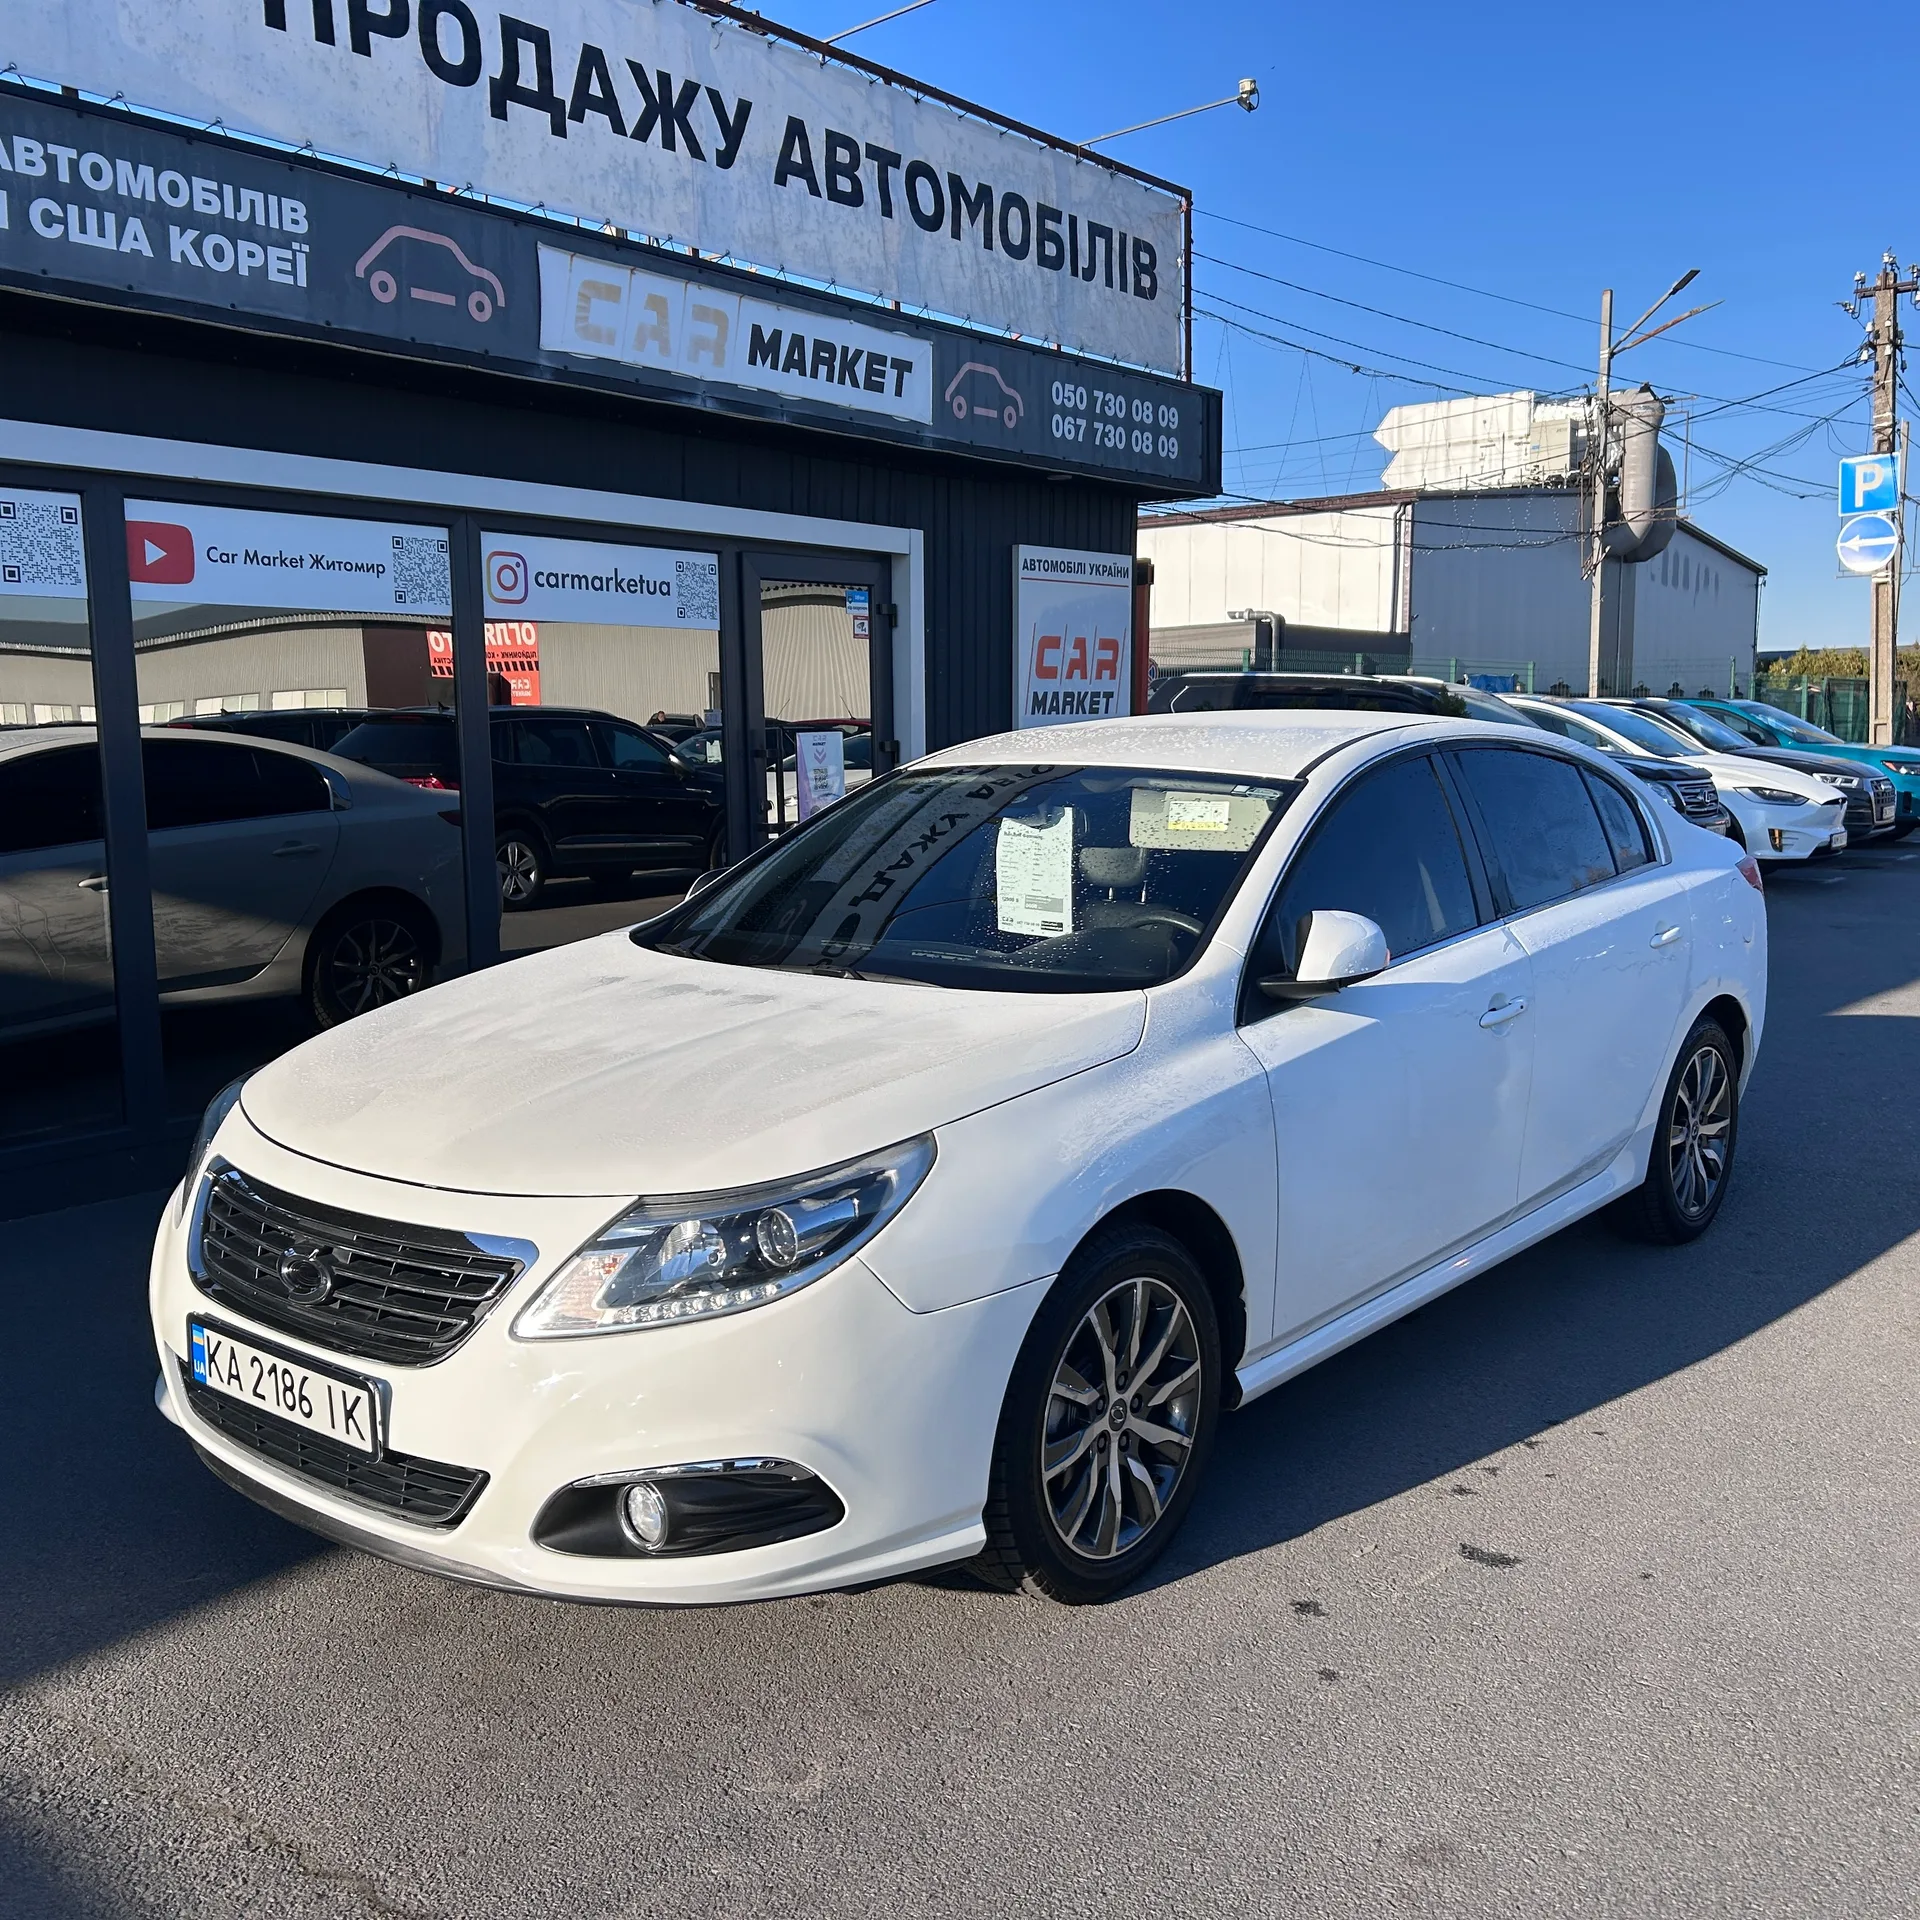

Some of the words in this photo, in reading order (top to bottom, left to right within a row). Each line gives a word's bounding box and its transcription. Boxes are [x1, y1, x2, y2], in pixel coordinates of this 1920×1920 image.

[773, 115, 1158, 301] АВТОМОБІЛІВ
[28, 197, 154, 258] США
[168, 225, 310, 288] КОРЕЇ
[574, 279, 730, 369] CAR
[747, 323, 914, 398] MARKET
[1052, 381, 1087, 411] 050
[1093, 390, 1127, 419] 730
[1131, 399, 1153, 424] 08
[1158, 404, 1179, 429] 09
[1052, 414, 1087, 442] 067
[1093, 422, 1127, 450] 730
[1131, 430, 1153, 455] 08
[1158, 435, 1179, 459] 09
[1854, 463, 1885, 508] P
[206, 546, 238, 564] Car
[243, 549, 304, 569] Market
[308, 553, 386, 578] Житомир
[533, 567, 671, 597] carmarketua
[1022, 558, 1086, 574] АВТОМОБІЛІ
[1089, 562, 1129, 579] УКРАЇНИ
[1035, 635, 1119, 680] CAR
[1030, 691, 1114, 715] MARKET
[194, 1359, 206, 1376] UA
[206, 1335, 243, 1392] KA
[250, 1356, 313, 1419] 2186
[327, 1384, 366, 1442] IK
